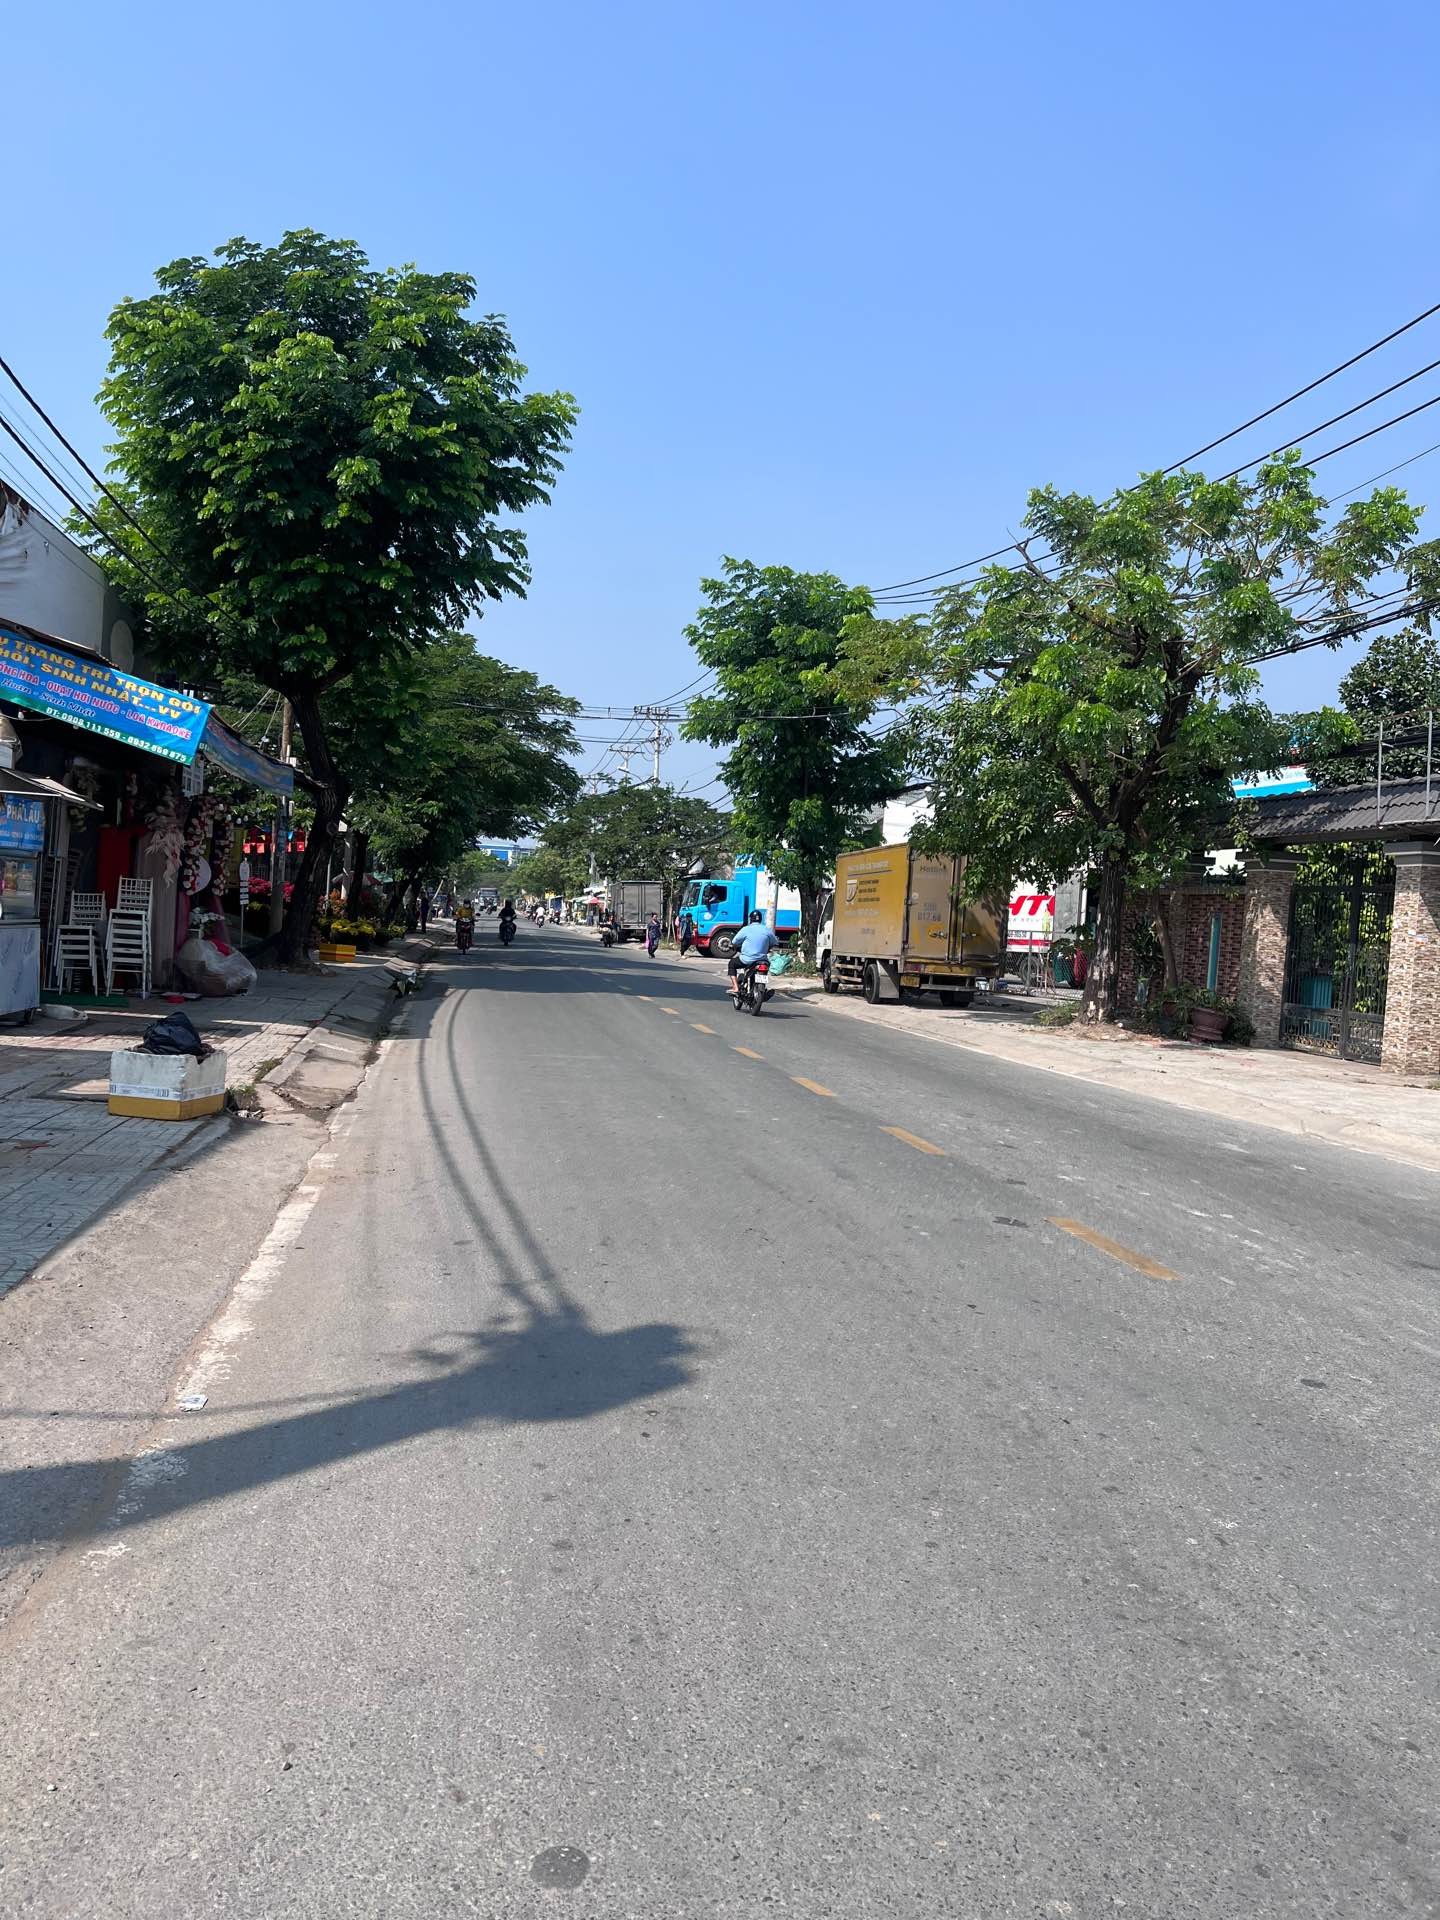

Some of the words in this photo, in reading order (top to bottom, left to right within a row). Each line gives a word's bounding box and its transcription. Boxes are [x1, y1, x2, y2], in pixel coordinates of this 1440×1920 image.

[15, 640, 76, 669] TRANG
[81, 664, 111, 681] TRÍ
[116, 676, 164, 702] TRỌN
[168, 697, 202, 715] GÓI
[40, 663, 86, 685] SINH
[18, 669, 39, 685] HOA
[47, 680, 73, 697] QUẠT
[126, 709, 146, 723] LOA
[146, 716, 192, 740] KARAOKE
[86, 721, 101, 732] 111
[103, 727, 121, 739] 559
